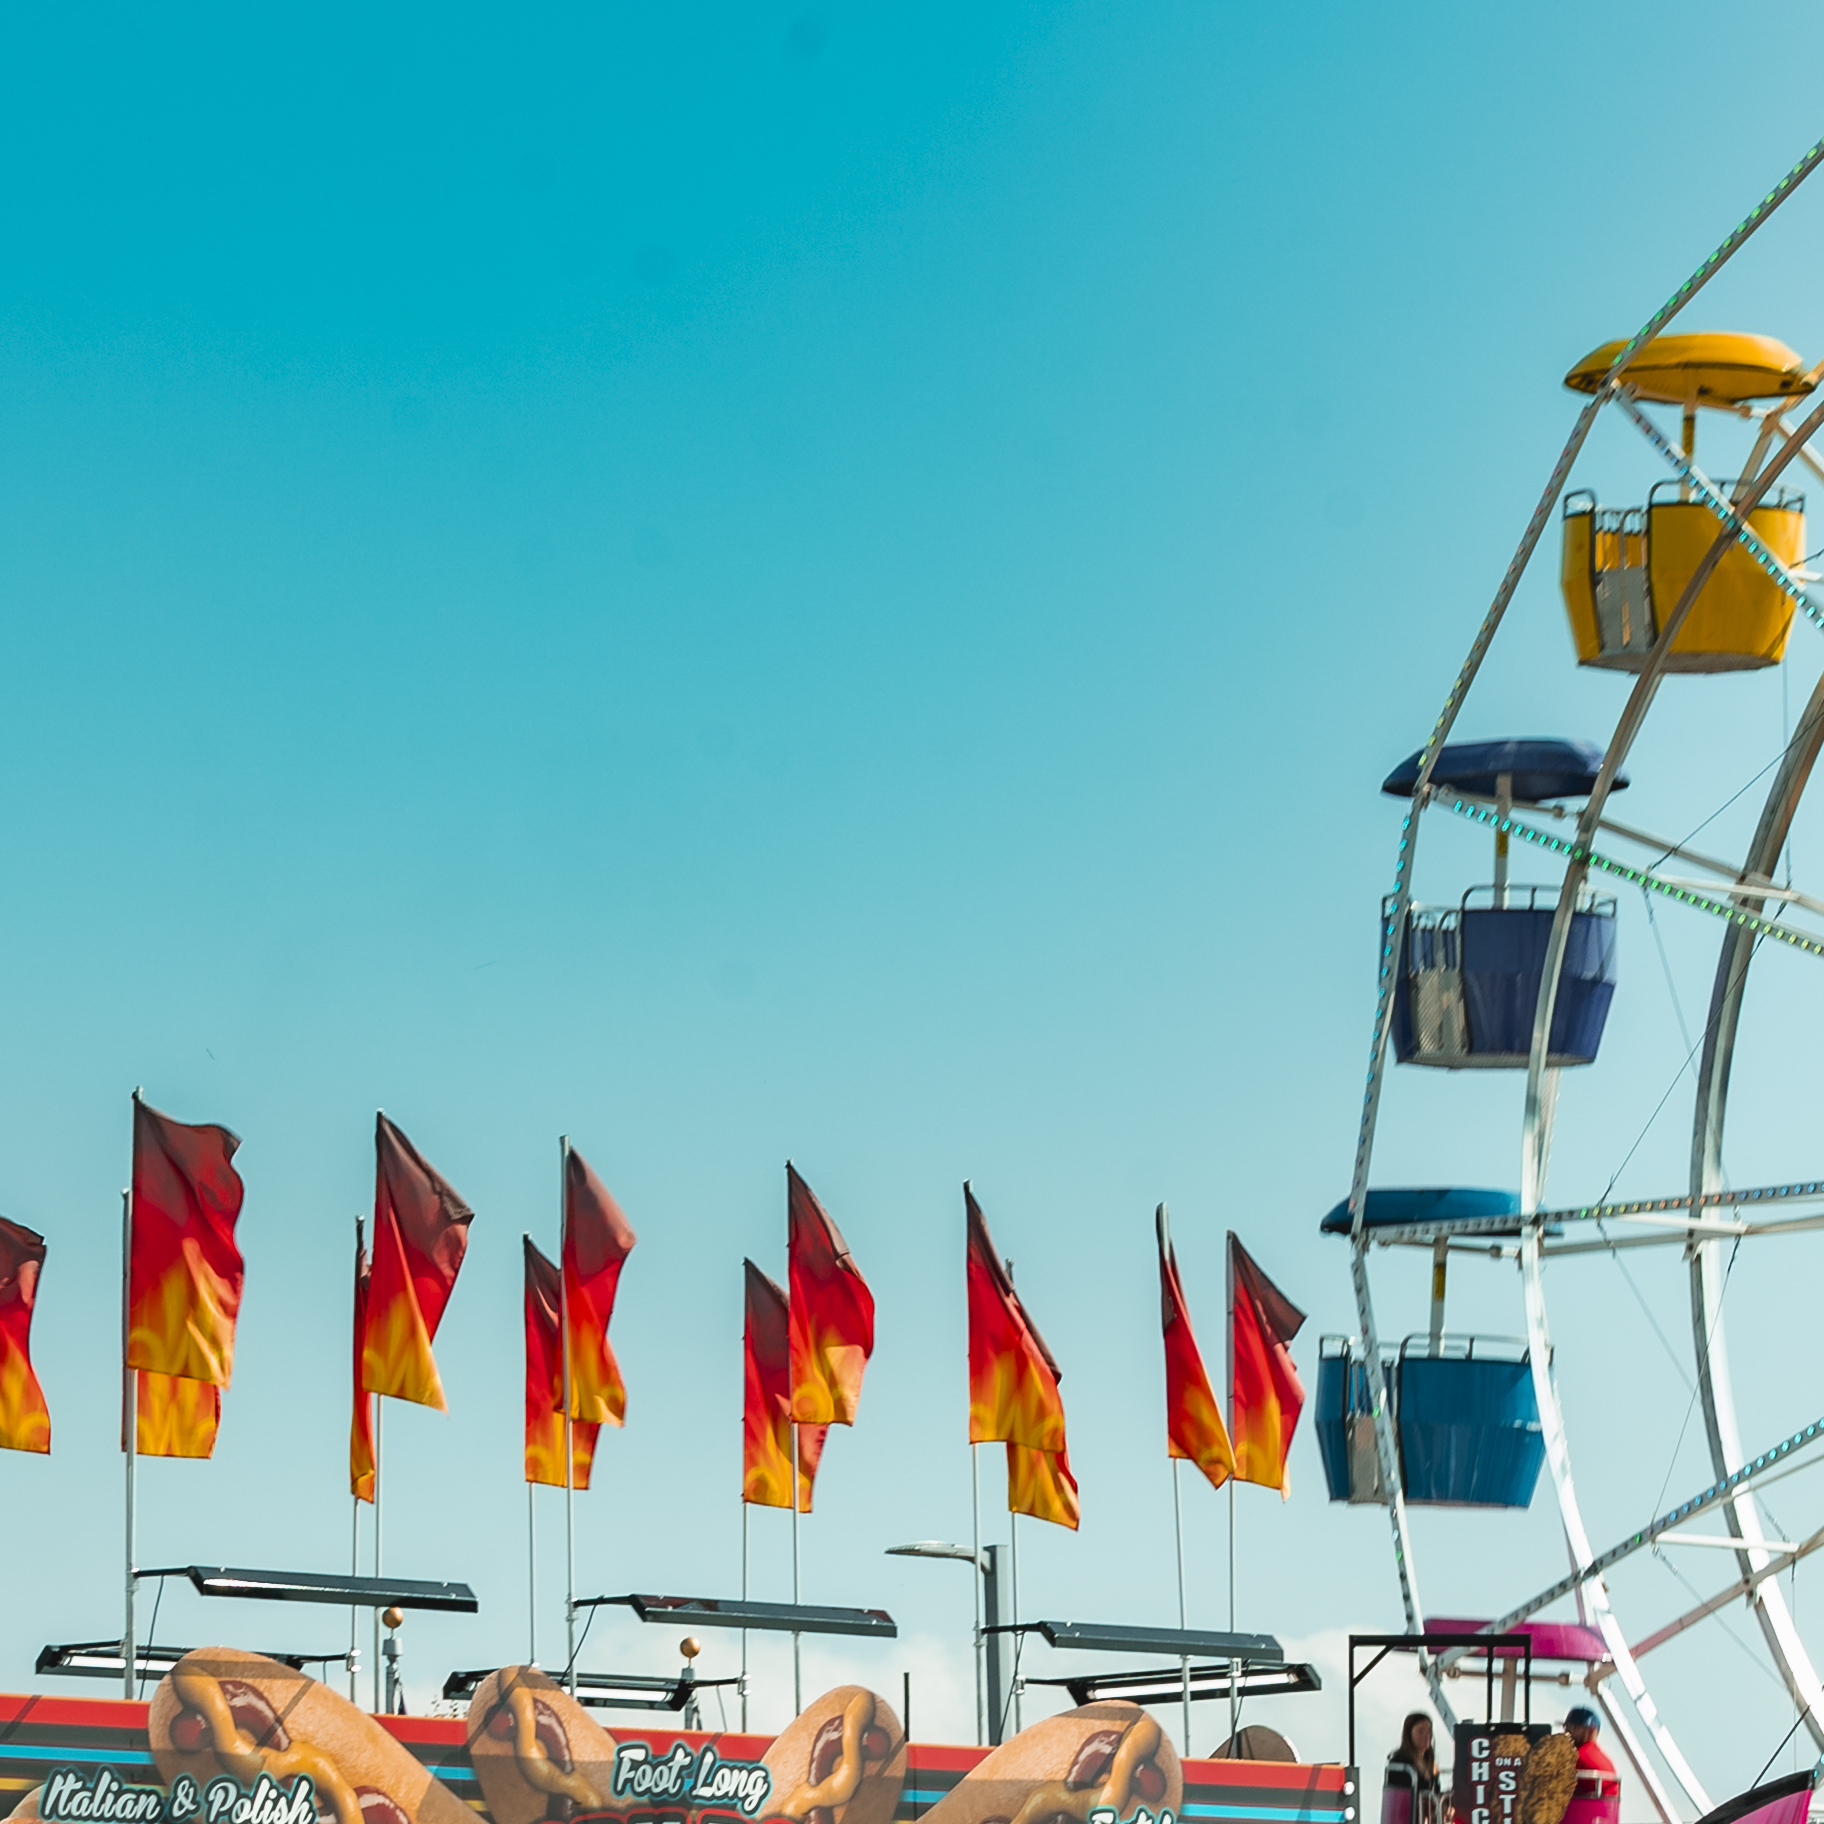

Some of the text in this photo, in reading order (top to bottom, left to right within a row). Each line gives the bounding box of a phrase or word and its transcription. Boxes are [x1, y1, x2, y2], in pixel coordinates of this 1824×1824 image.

[42, 1770, 160, 1821] Italian
[173, 1778, 198, 1816] &
[616, 1746, 770, 1811] Foot Long
